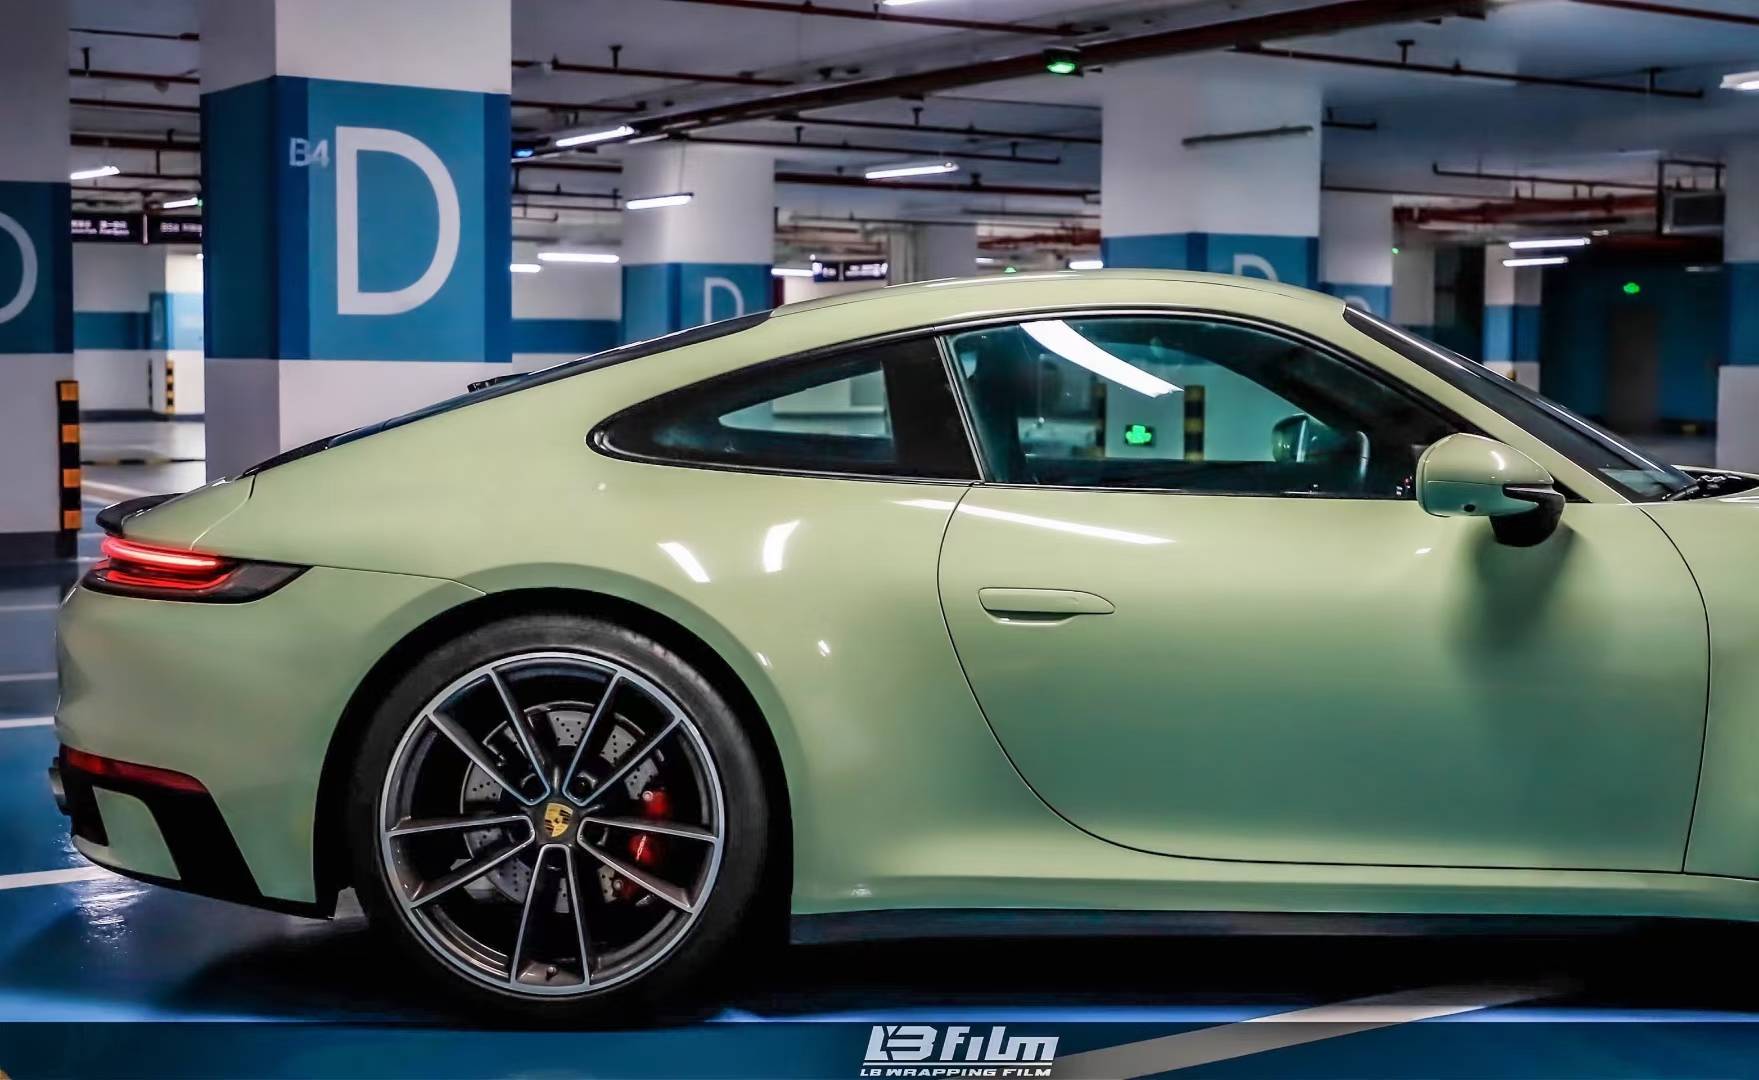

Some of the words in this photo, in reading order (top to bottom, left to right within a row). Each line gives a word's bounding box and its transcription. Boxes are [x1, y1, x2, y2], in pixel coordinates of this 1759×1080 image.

[289, 138, 330, 167] B4
[336, 126, 460, 315] D
[704, 277, 745, 323] D
